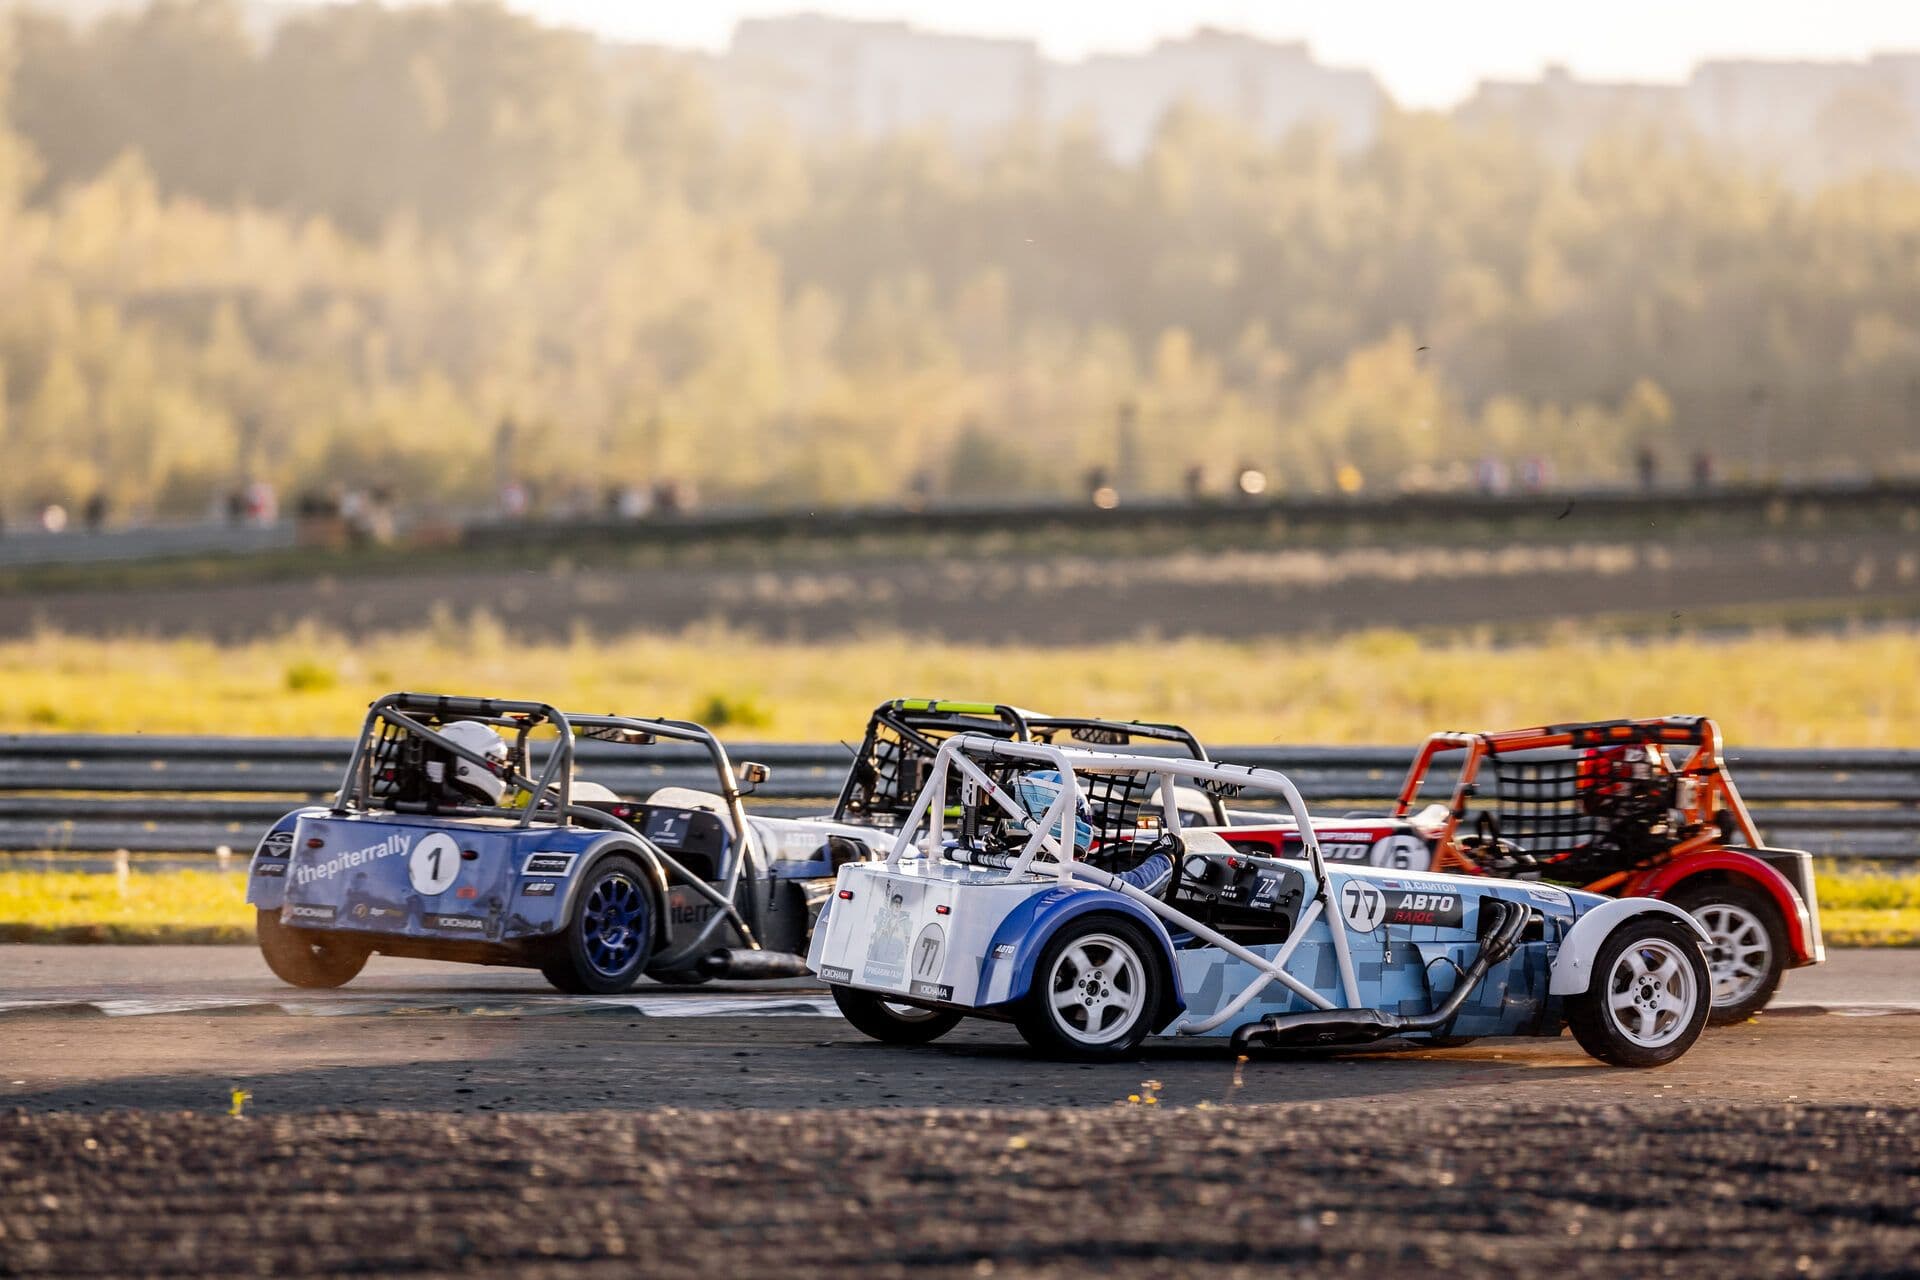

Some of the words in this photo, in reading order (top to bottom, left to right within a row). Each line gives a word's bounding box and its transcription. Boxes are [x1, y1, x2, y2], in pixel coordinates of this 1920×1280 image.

[663, 818, 675, 833] 1
[296, 834, 412, 885] thepiterrally
[427, 847, 443, 881] 1
[1393, 844, 1411, 870] 6
[1258, 878, 1277, 894] 77
[1345, 889, 1379, 920] 77
[1398, 894, 1454, 912] АВТО
[918, 937, 941, 977] 77
[994, 944, 1015, 955] АВТО
[821, 968, 849, 982] YOKOHAMA
